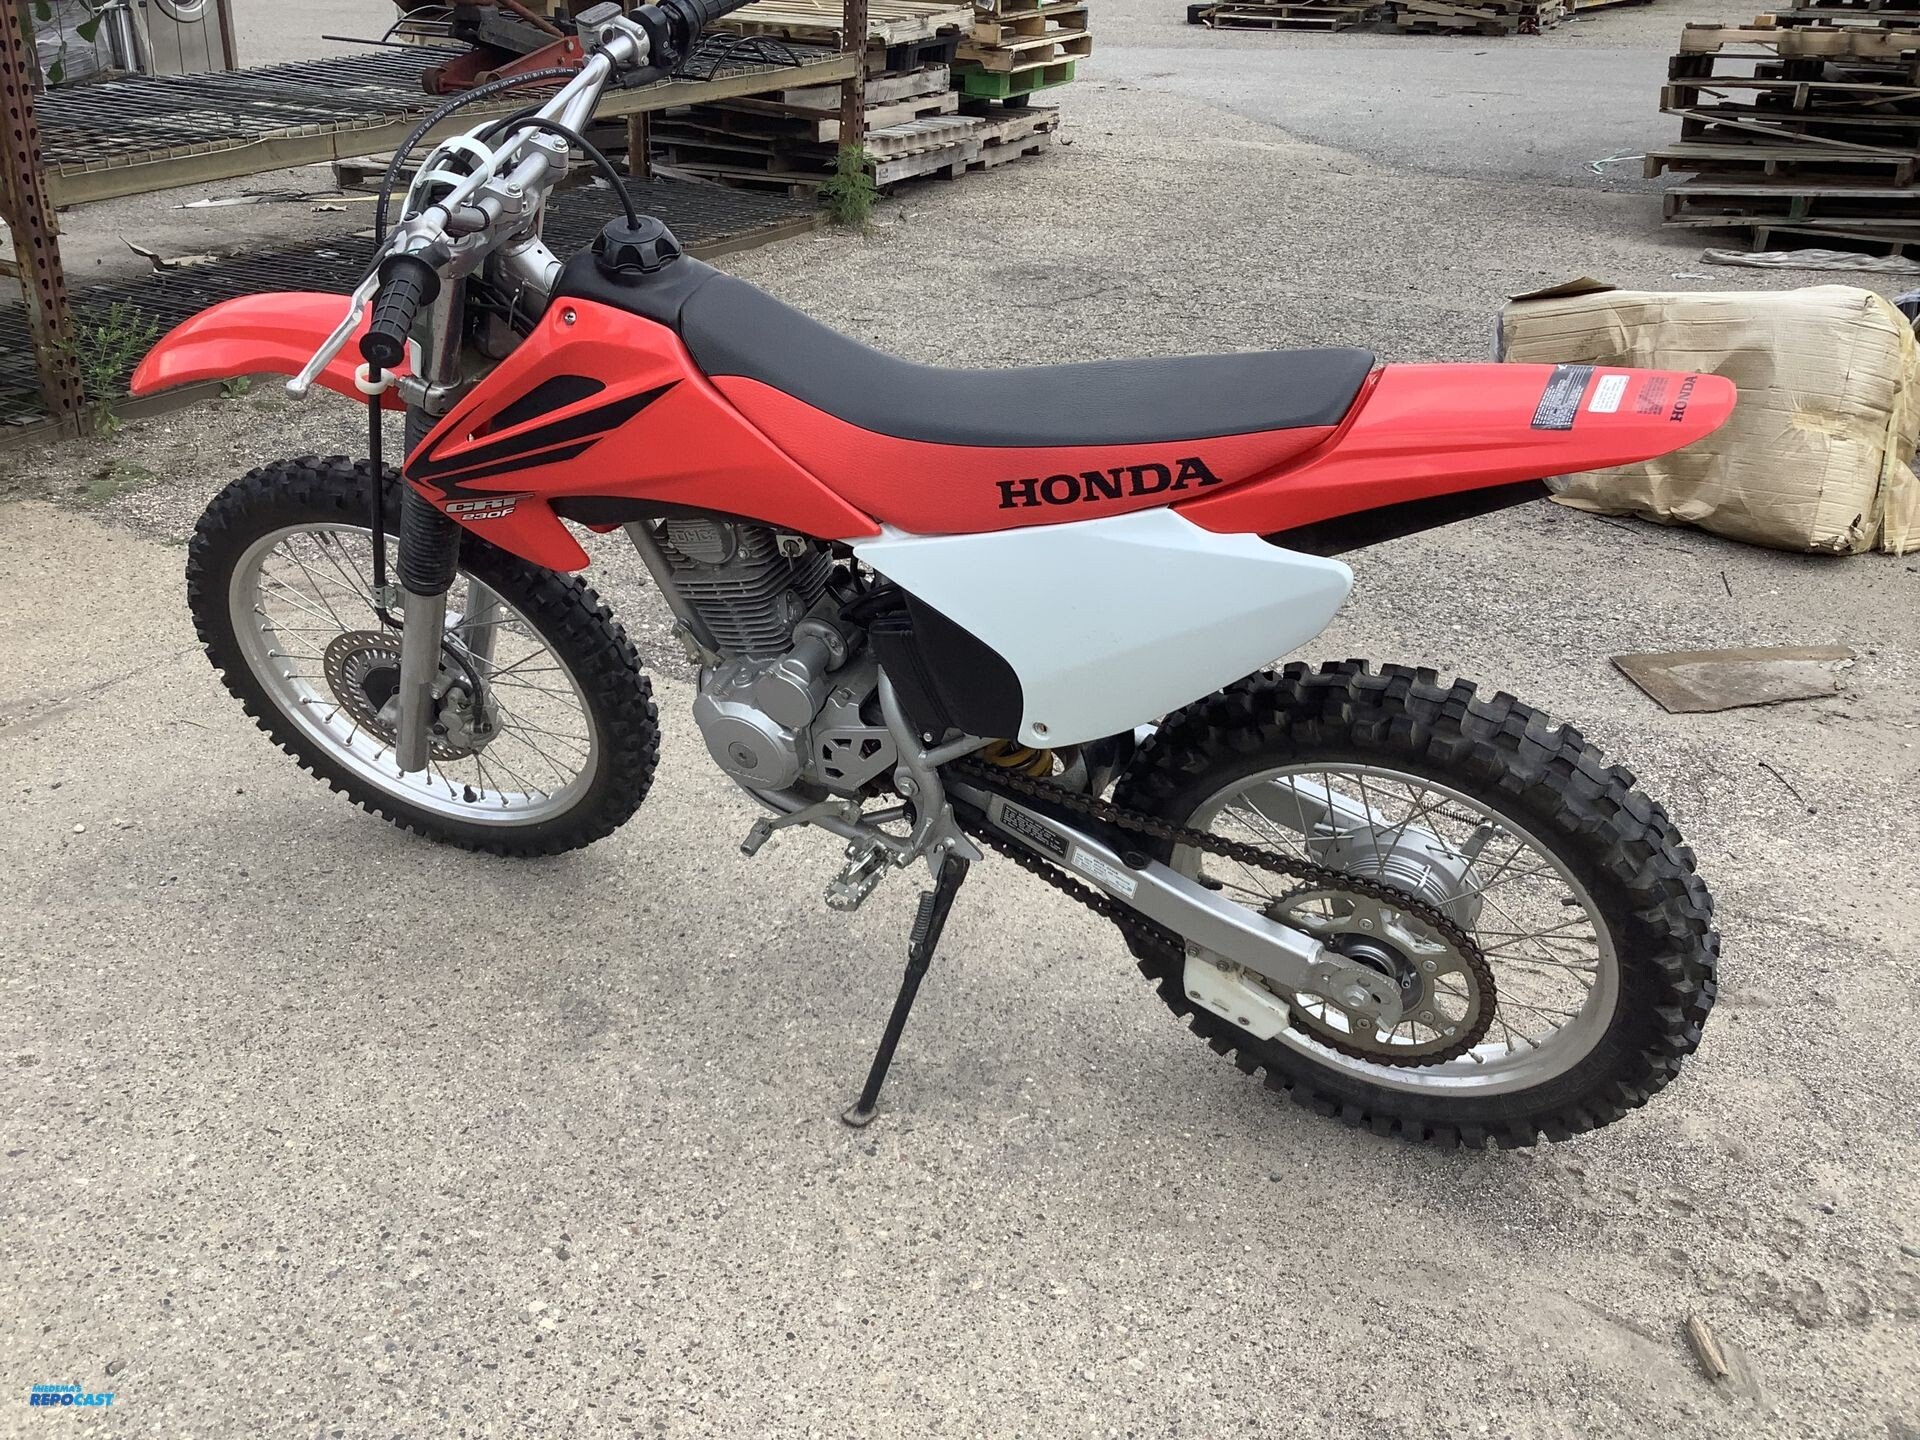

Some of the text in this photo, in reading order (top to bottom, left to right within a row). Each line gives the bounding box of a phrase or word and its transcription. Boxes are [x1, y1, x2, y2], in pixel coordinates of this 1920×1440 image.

[1670, 376, 1697, 422] HONDA
[996, 456, 1223, 508] HONDA
[446, 496, 522, 513] CRF
[461, 507, 515, 520] 230F
